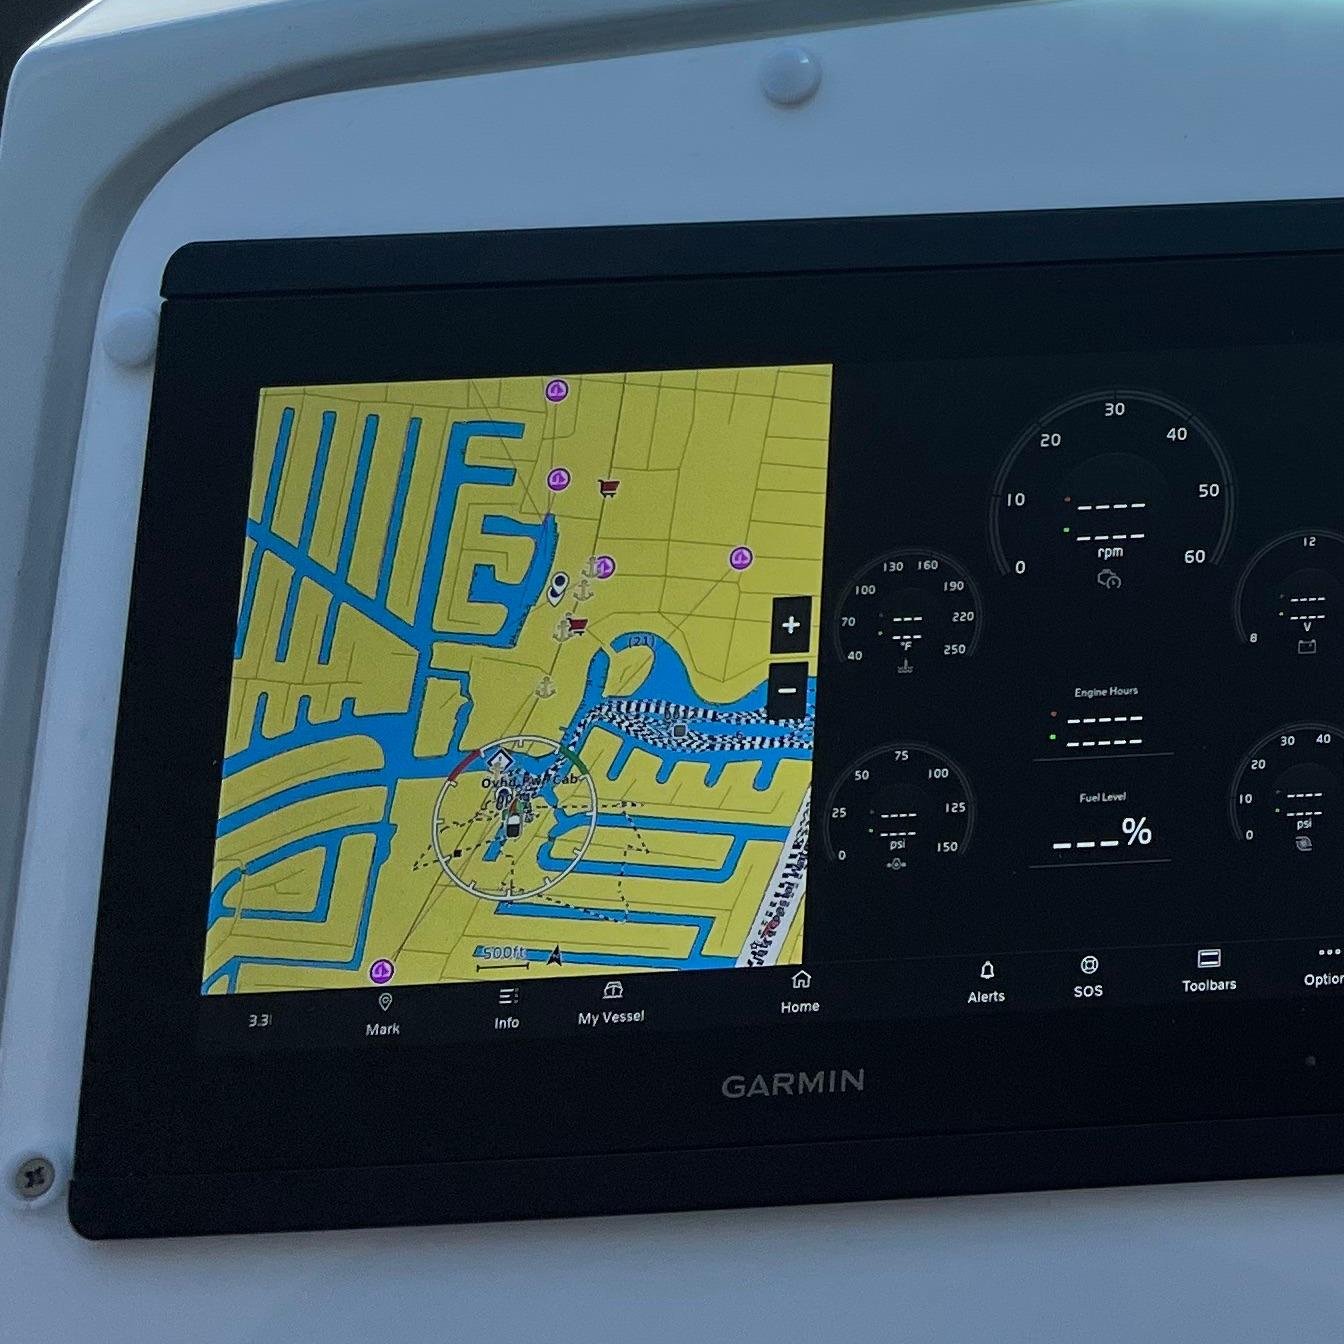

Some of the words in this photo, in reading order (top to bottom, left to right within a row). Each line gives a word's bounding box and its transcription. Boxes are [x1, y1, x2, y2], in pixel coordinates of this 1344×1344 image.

[1104, 402, 1125, 417] 30
[1166, 427, 1188, 441] 40
[1040, 433, 1061, 448] 20
[1199, 484, 1220, 498] 50
[1007, 493, 1025, 507] 10
[1303, 537, 1317, 547] 12
[1097, 546, 1124, 560] rpm
[1184, 550, 1206, 564] 60
[883, 562, 904, 572] 130
[918, 560, 938, 570] 160
[1015, 561, 1026, 575] 0
[856, 585, 876, 595] 100
[944, 581, 964, 591] 190
[842, 617, 856, 627] 70
[952, 611, 974, 622] 220
[1303, 622, 1312, 632] V
[1250, 633, 1258, 643] 8
[901, 641, 912, 651] °F
[944, 644, 966, 655] 250
[848, 651, 862, 661] 40
[1075, 688, 1107, 698] Engine
[1109, 687, 1138, 696] Hours
[1281, 735, 1295, 746] 30
[1316, 734, 1331, 744] 40
[894, 750, 909, 761] 75
[1251, 759, 1266, 770] 20
[855, 770, 869, 781] 50
[928, 768, 949, 779] 100
[1080, 793, 1100, 803] Fuel
[1102, 792, 1127, 802] Level
[1240, 794, 1252, 804] 10
[832, 808, 847, 818] 25
[945, 802, 966, 813] 125
[1297, 818, 1312, 830] psi
[1246, 830, 1253, 840] 0
[890, 839, 906, 850] psi
[938, 842, 958, 852] 150
[838, 850, 847, 860] 0
[1182, 978, 1237, 993] Toolbars
[967, 989, 1006, 1005] Alerts
[1073, 985, 1103, 998] SOS
[781, 1001, 820, 1014] Home
[578, 1012, 599, 1027] My
[602, 1009, 645, 1024] Vessel
[366, 1023, 400, 1036] Mark
[494, 1018, 520, 1030] Info
[721, 1068, 865, 1099] GARMIN
